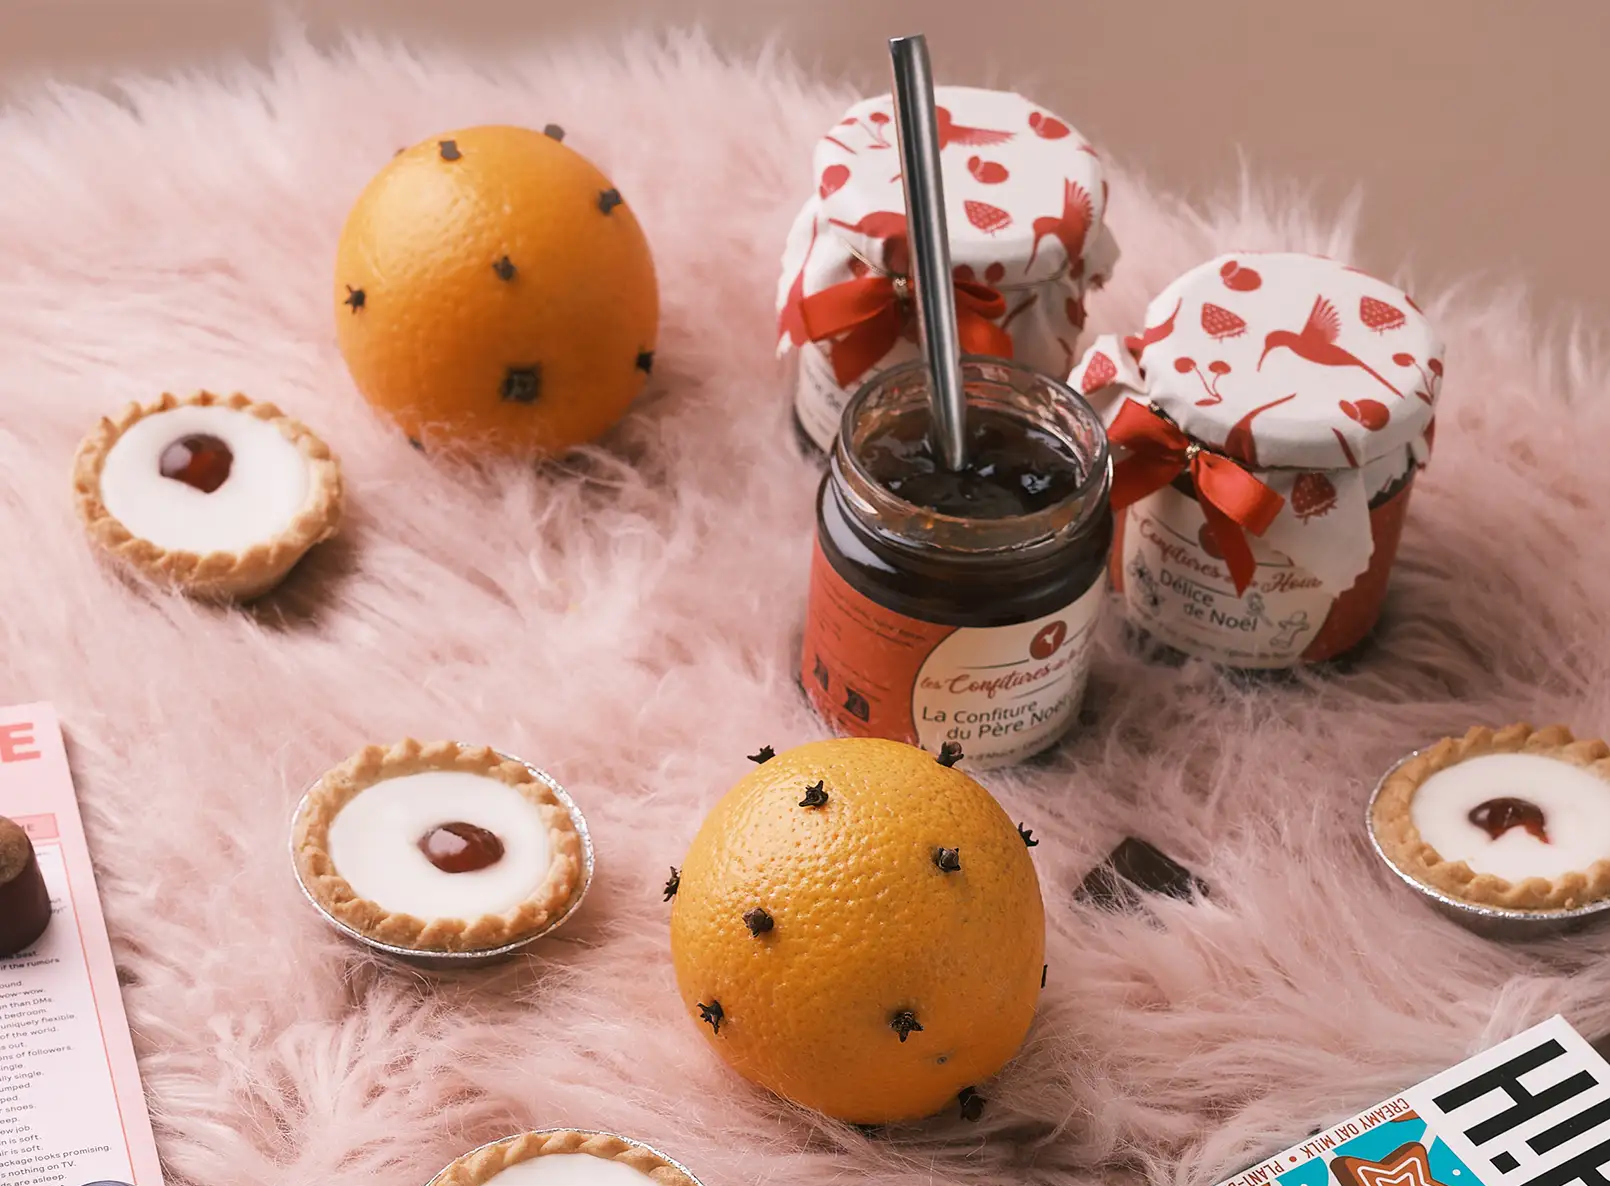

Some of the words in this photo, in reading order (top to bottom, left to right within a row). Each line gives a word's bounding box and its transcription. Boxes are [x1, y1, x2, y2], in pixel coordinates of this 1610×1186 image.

[1160, 569, 1215, 606] Délice
[1184, 602, 1205, 618] de
[944, 661, 1052, 699] Confitures
[922, 706, 947, 723] La
[954, 701, 1038, 725] Confiture
[947, 726, 972, 741] du
[978, 719, 1025, 740] Père
[10, 1000, 31, 1009] than
[1, 1017, 40, 1030] uniquely
[12, 1030, 28, 1038] the
[30, 1026, 59, 1036] world.
[16, 1050, 26, 1058] of
[28, 1045, 74, 1057] followers.
[14, 1070, 44, 1080] single.
[5, 1103, 36, 1113] shoes.
[1359, 1097, 1410, 1130] CREAMY
[15, 1125, 33, 1134] job.
[1334, 1123, 1360, 1143] OAT
[9, 1137, 17, 1145] is
[19, 1133, 42, 1143] soft.
[21, 1144, 44, 1154] soft.
[34, 1152, 61, 1162] looks
[63, 1144, 112, 1159] promising.
[8, 1166, 45, 1178] nothing
[61, 1160, 76, 1169] TV.
[14, 1179, 31, 1186] are
[32, 1173, 67, 1184] asleep.
